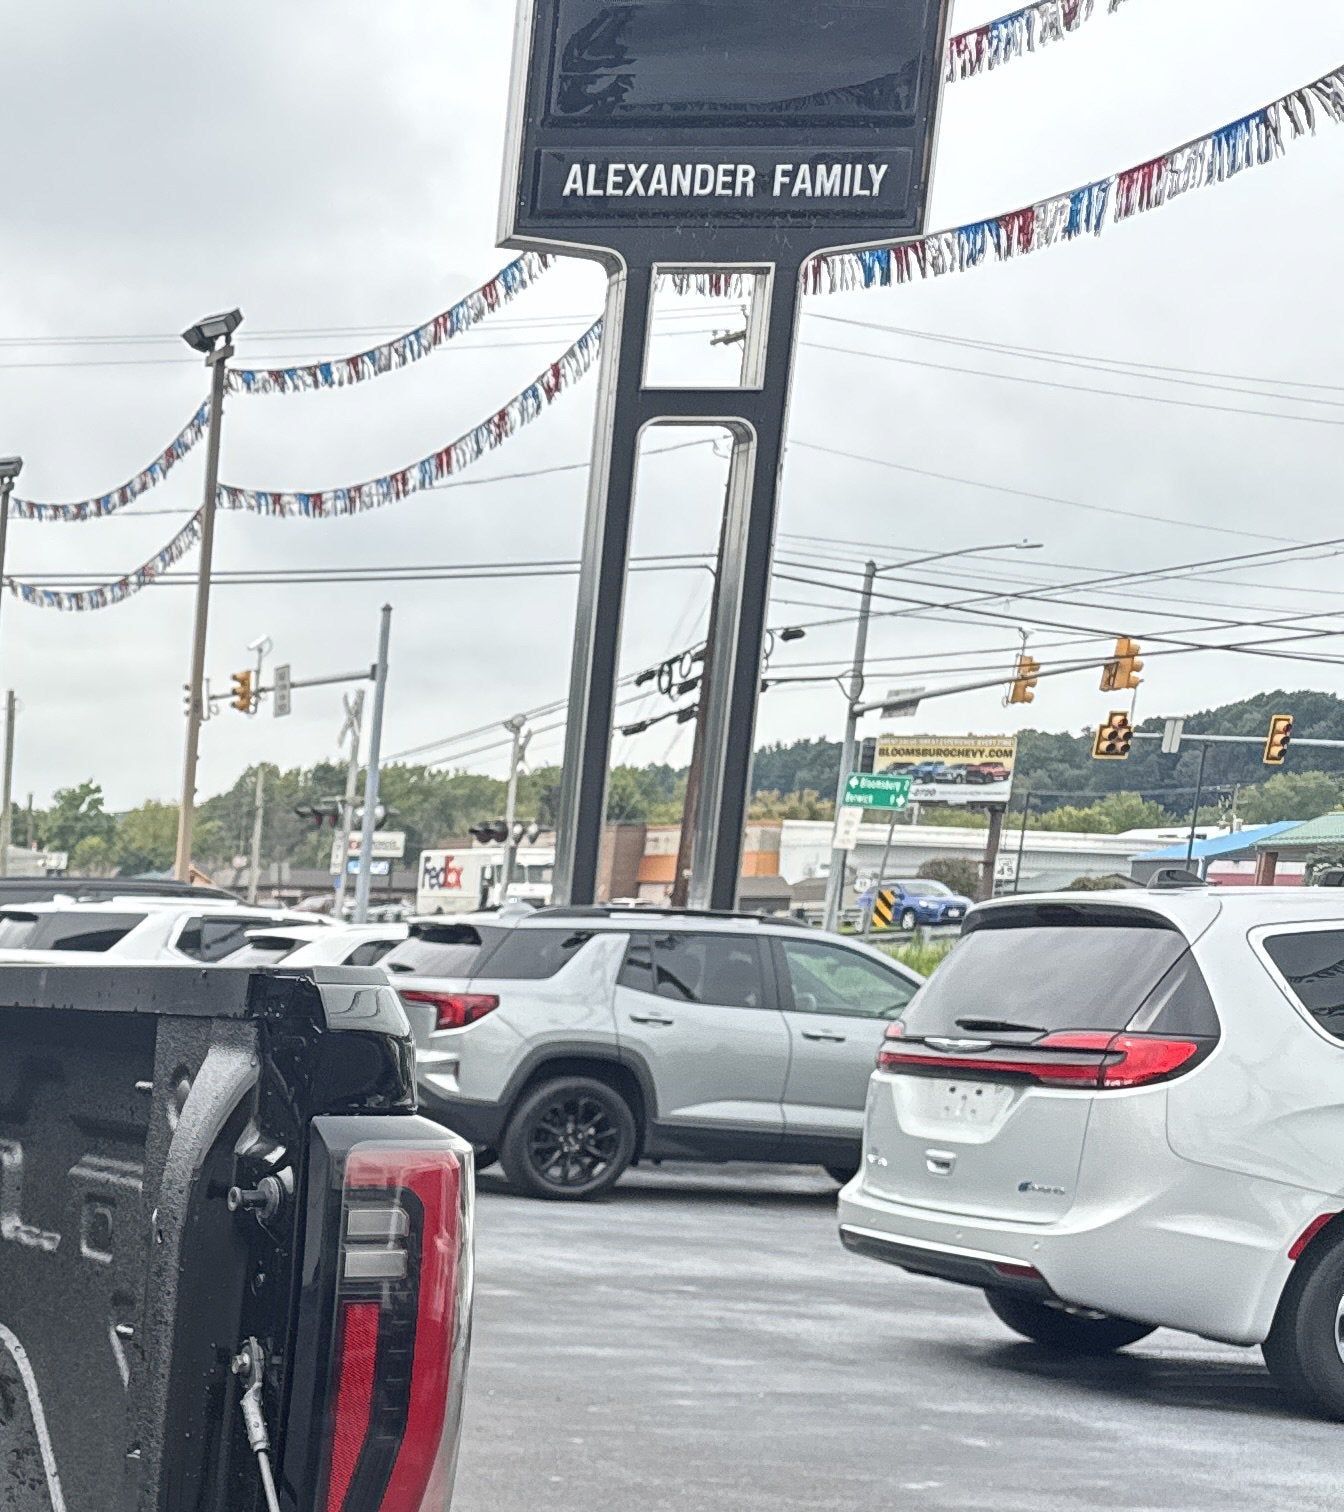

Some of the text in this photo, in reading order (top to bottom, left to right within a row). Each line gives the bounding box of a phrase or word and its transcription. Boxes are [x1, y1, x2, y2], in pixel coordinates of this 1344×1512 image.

[562, 163, 889, 198] ALEXANDER FAMILY
[422, 854, 464, 890] FedEx
